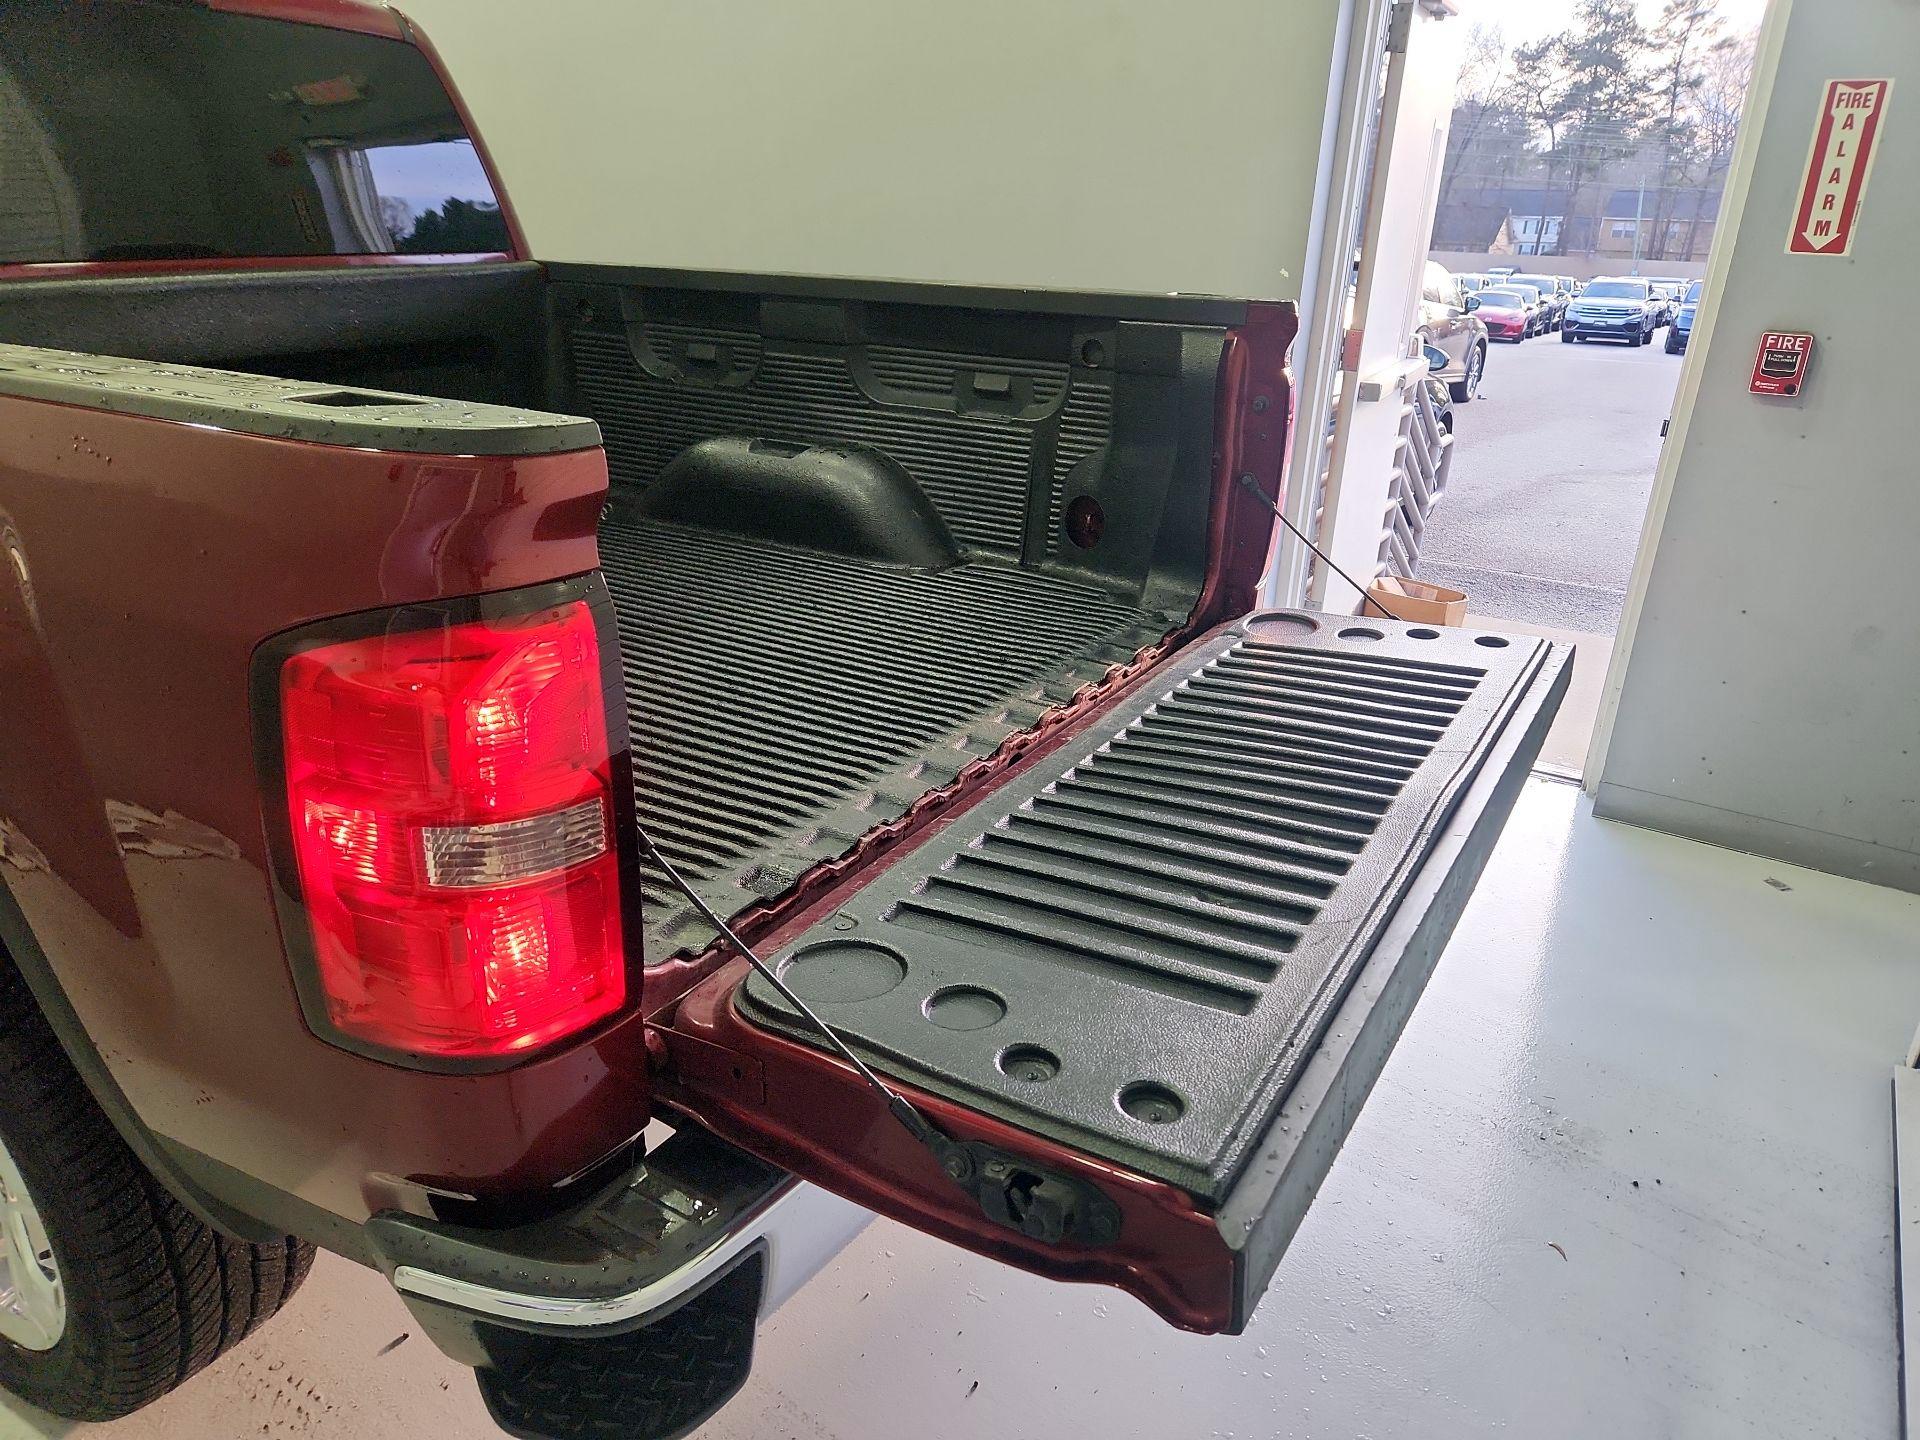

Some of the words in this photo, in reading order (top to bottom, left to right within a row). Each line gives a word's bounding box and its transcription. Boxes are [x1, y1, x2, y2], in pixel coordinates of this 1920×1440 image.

[1835, 92, 1874, 108] FIRE
[1813, 113, 1854, 237] ALARM
[1766, 335, 1806, 350] FIRE
